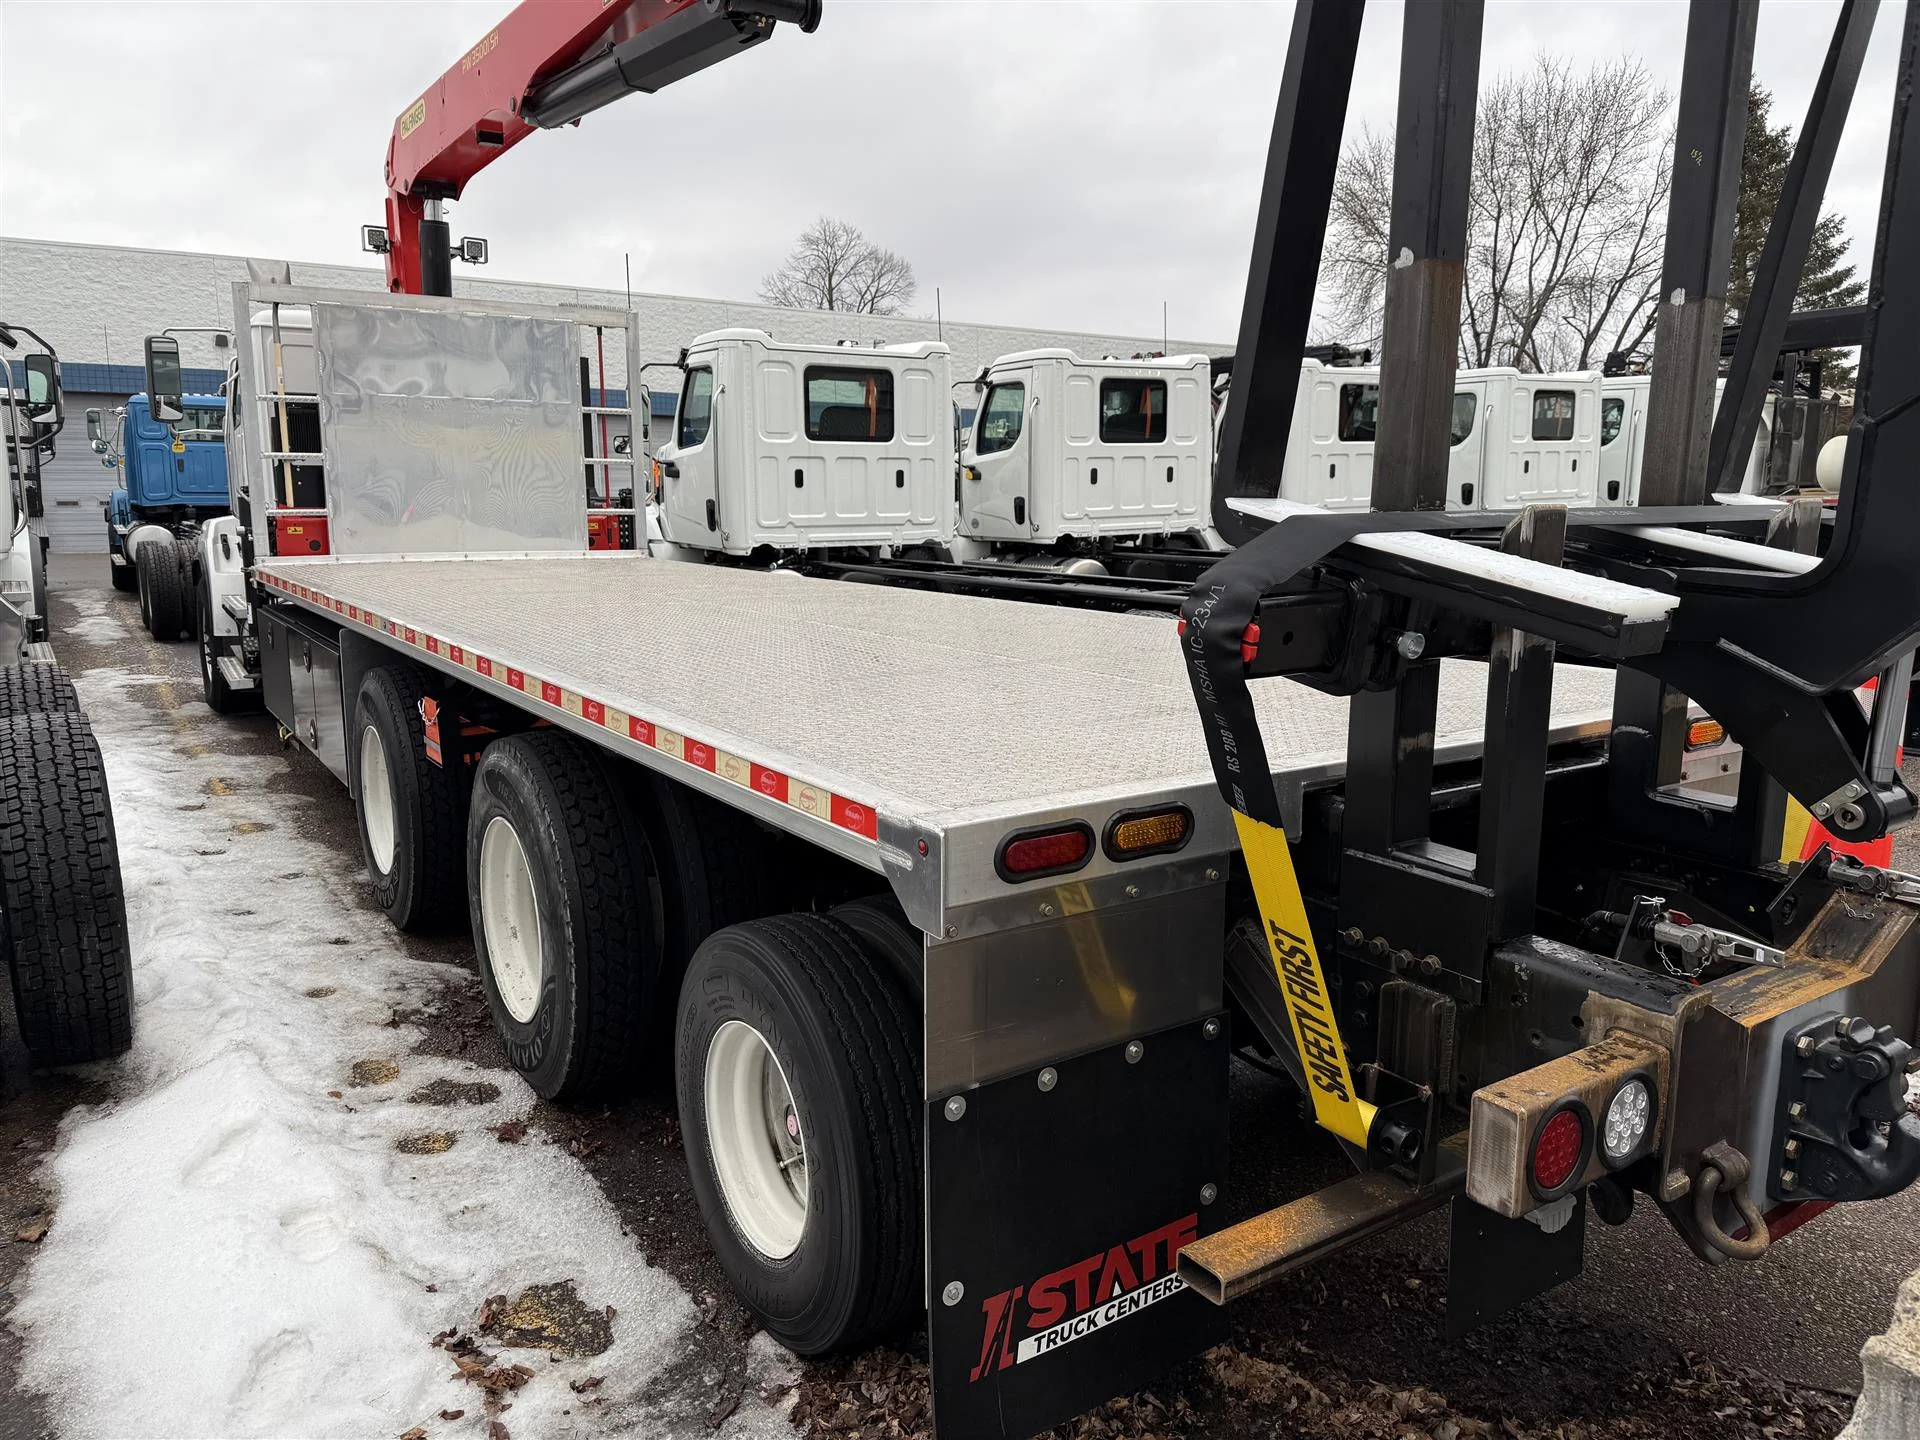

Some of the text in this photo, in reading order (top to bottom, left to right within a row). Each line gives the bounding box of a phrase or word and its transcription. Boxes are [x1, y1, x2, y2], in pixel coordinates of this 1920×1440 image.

[401, 102, 425, 137] PALFINGER
[1190, 584, 1226, 654] IC-234/1
[1193, 660, 1219, 704] MSHA
[1226, 755, 1241, 773] RS
[1268, 917, 1351, 1104] SAFETY FIRST
[1033, 1274, 1185, 1354] TRUCK CENTERS
